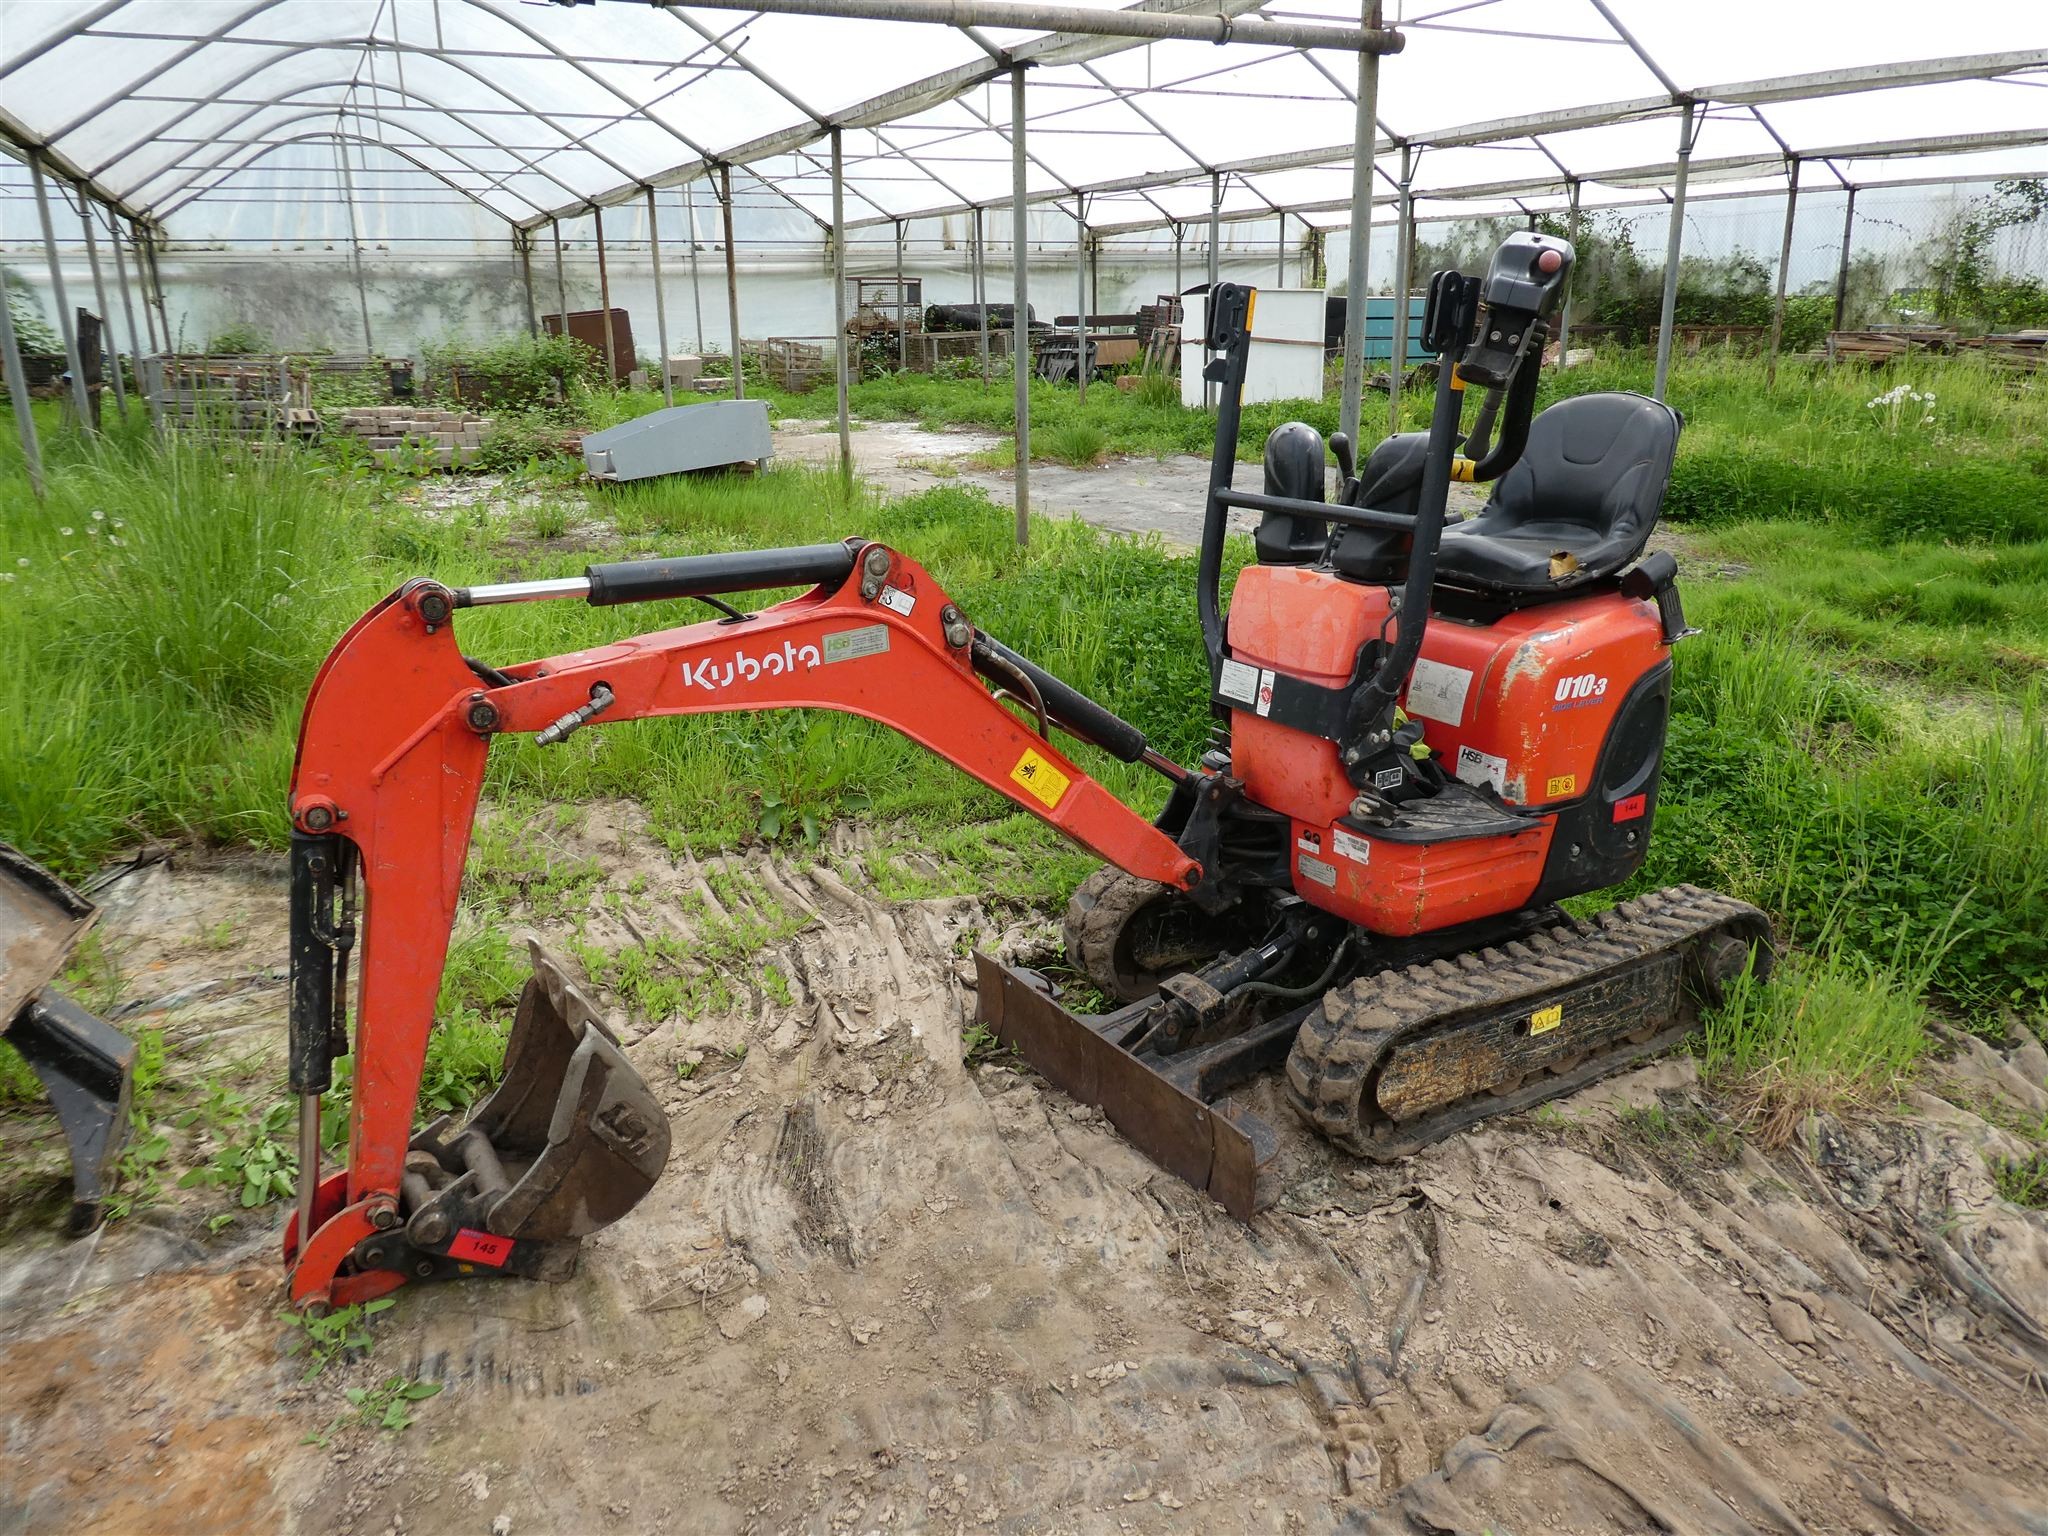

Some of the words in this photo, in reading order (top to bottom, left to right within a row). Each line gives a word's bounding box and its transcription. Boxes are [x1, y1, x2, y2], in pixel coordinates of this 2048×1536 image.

[682, 640, 821, 690] Kubota
[1554, 673, 1608, 701] U10-3
[473, 1241, 497, 1254] 145
